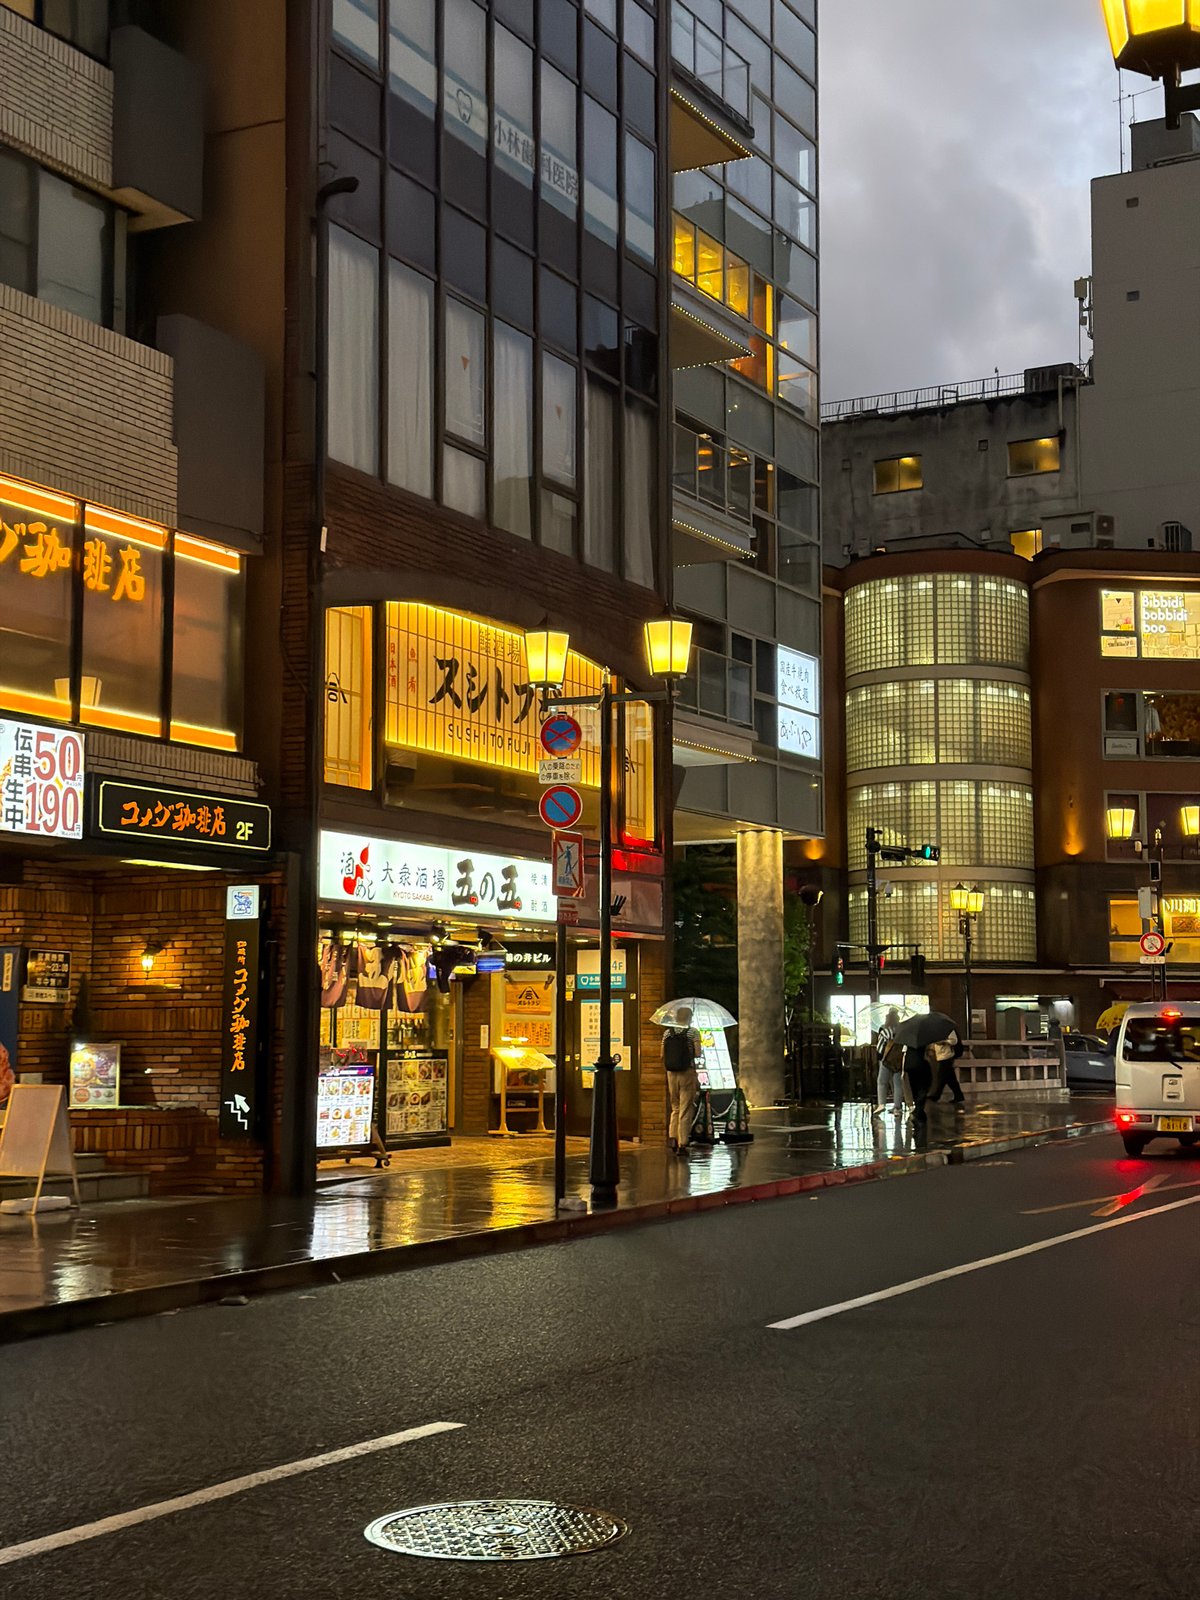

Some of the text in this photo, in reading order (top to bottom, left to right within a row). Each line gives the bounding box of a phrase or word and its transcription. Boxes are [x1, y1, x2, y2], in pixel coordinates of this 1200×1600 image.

[1143, 595, 1184, 608] Bibbidi
[1143, 608, 1188, 621] bobbidi
[1143, 622, 1167, 633] boo
[14, 727, 33, 777] 伝串
[448, 723, 486, 745] SUSHI
[490, 733, 504, 749] TO
[508, 739, 531, 755] FUJI
[34, 731, 80, 781] 50
[5, 779, 24, 829] 生中
[26, 782, 79, 833] 190
[121, 801, 254, 841] コメダ珈琲店 2F
[381, 861, 446, 892] 大衆酒場
[451, 858, 523, 912] 五の五
[393, 891, 434, 901] KYOTO SAKABA
[1162, 898, 1200, 913] 小川珈
[612, 960, 623, 970] 4F
[230, 968, 250, 1072] コメダ珈琲店
